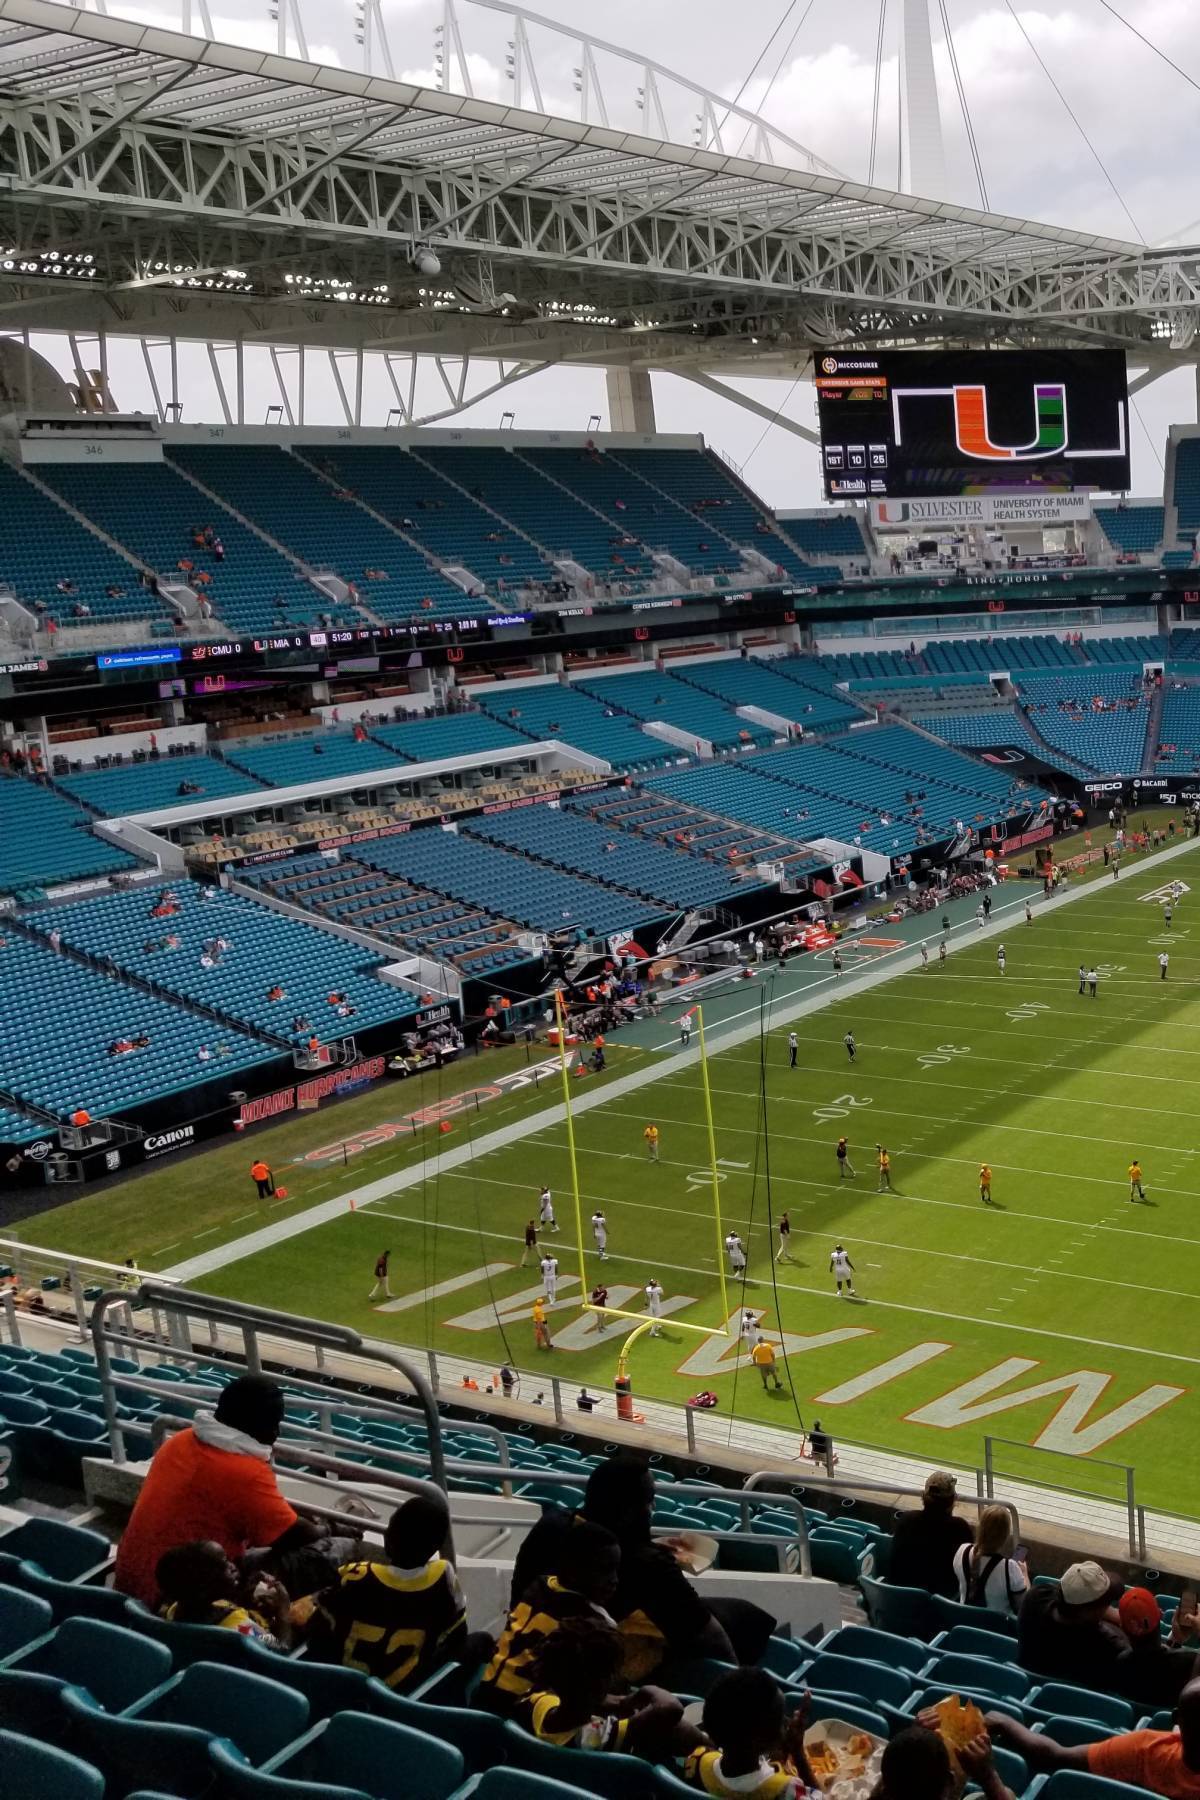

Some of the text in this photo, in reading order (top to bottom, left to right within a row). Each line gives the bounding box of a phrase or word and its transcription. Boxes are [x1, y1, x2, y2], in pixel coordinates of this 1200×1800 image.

[209, 428, 225, 437] 347
[85, 445, 102, 454] 346
[828, 456, 841, 464] 1ST
[852, 455, 862, 464] 10
[911, 497, 1084, 517] SYLVESTER UNIVERSITY OF MIAMI
[993, 508, 1060, 520] HEALTH SYSTEM
[967, 577, 996, 585] RING
[1005, 575, 1048, 583] HONOR
[410, 626, 418, 634] 10
[274, 637, 301, 648] MIA 0
[332, 632, 352, 642] 51:20
[212, 644, 241, 655] CMU 0
[8, 662, 39, 673] JAMES
[1085, 782, 1122, 792] GEICO
[1005, 1001, 1051, 1019] 40
[916, 1044, 970, 1064] 30
[240, 1057, 386, 1124] MIAMI HURRICANES
[812, 1094, 873, 1119] 20
[144, 1126, 194, 1150] Canon
[686, 1157, 750, 1184] 10
[374, 1261, 1188, 1456] MIAMI
[342, 1619, 426, 1689] 52
